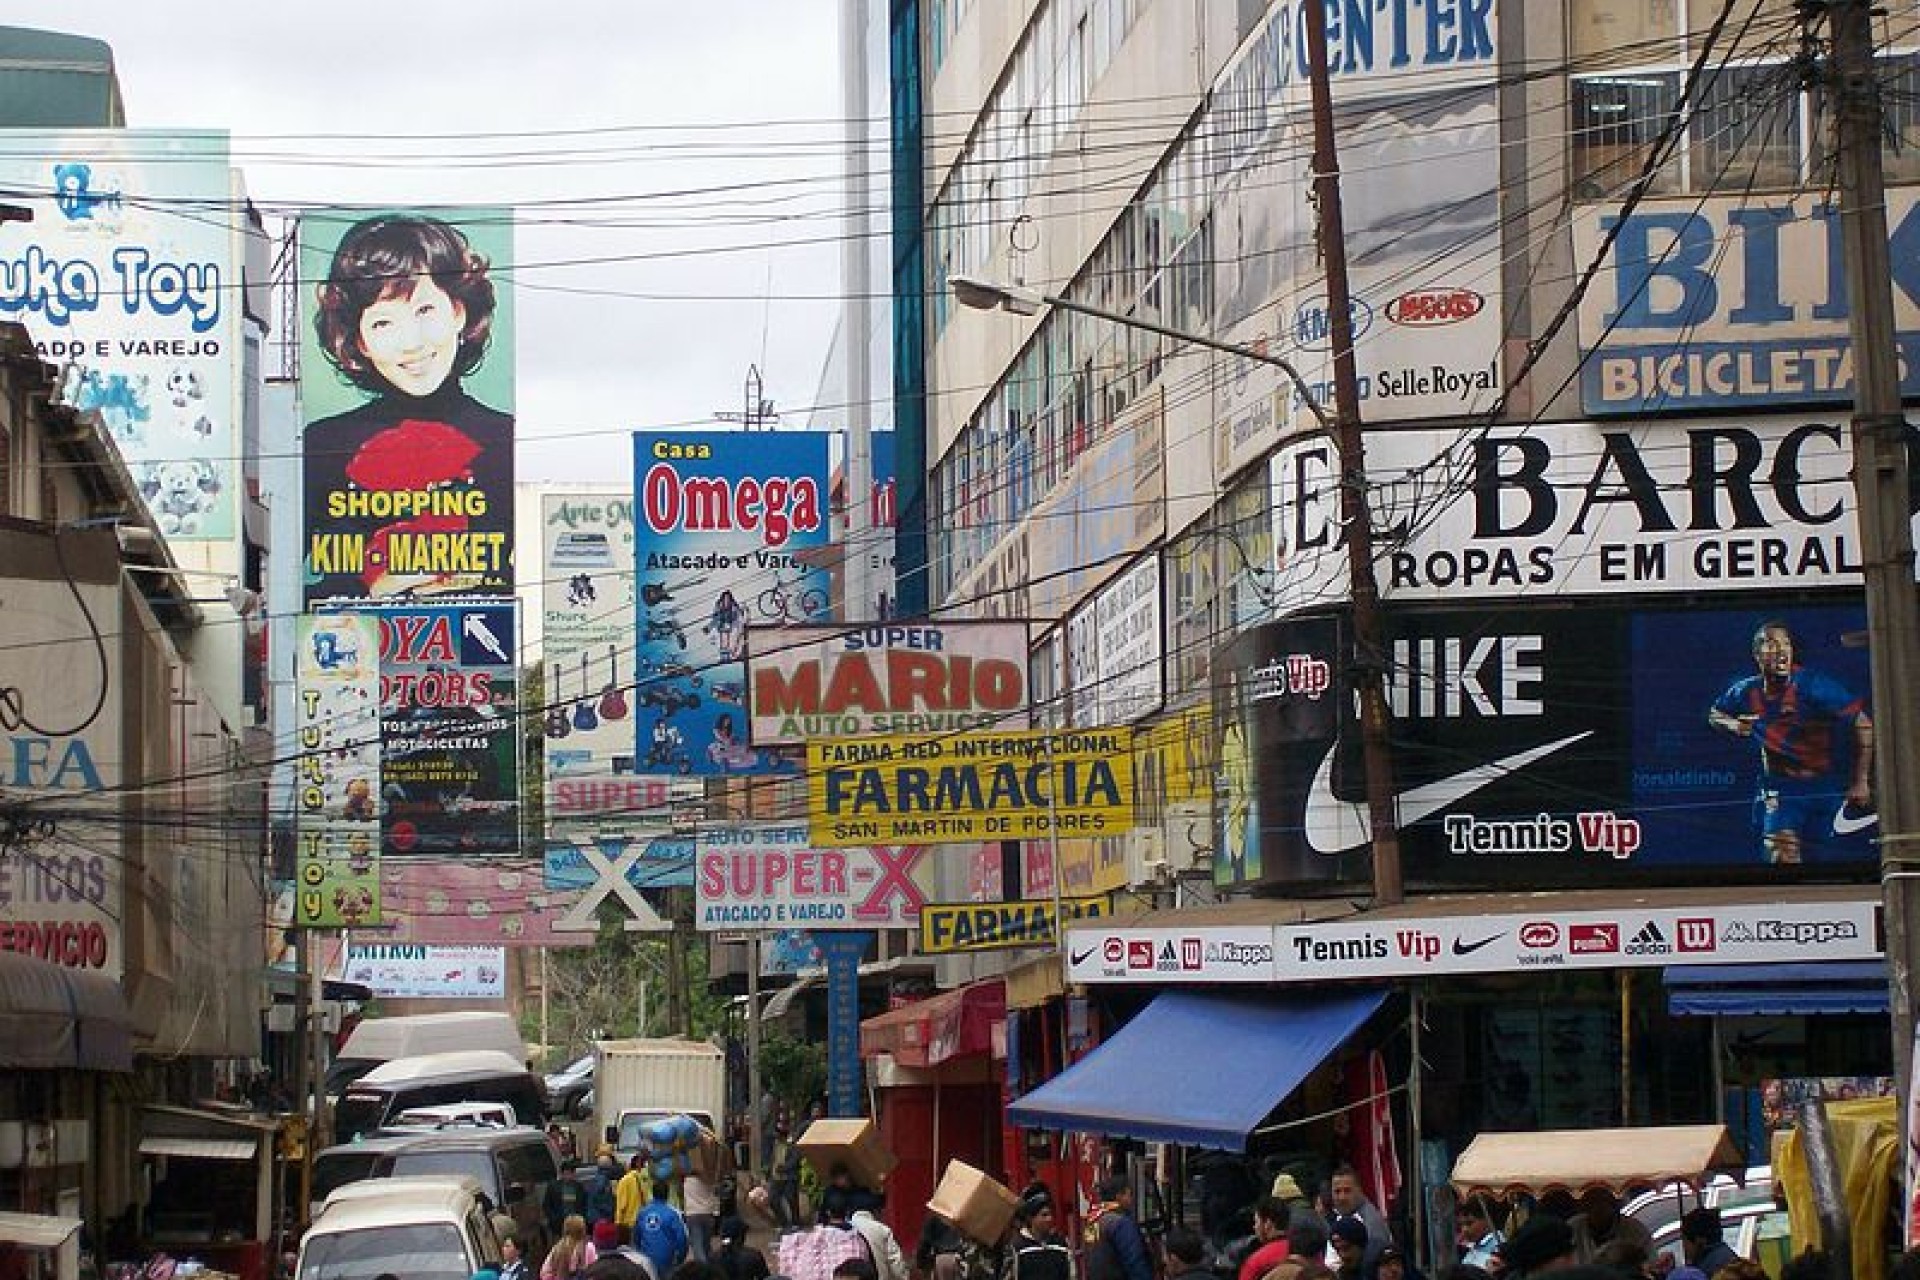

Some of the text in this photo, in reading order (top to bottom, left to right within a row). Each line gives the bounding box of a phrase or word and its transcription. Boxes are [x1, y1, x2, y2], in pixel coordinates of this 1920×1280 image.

[113, 247, 221, 333] Toy
[95, 340, 109, 357] E
[119, 339, 220, 357] VAREJO
[1377, 370, 1430, 399] Selle
[1432, 360, 1498, 401] Royal
[653, 442, 712, 460] Casa
[1472, 416, 1920, 541] BARC
[328, 490, 488, 518] SHOPPING
[642, 462, 821, 547] Omega
[311, 532, 506, 574] KIM MARKET
[646, 550, 731, 570] Atacado
[1390, 535, 1866, 588] ROPAS EM GERAL
[844, 626, 943, 651] SUPER
[755, 650, 1023, 717] MARIO
[1286, 653, 1330, 701] Vip
[779, 714, 860, 737] AUTO
[0, 736, 105, 792] FA
[823, 742, 893, 762] FARMA
[555, 783, 668, 812] SUPER
[824, 759, 1122, 815] FARMACIA
[834, 821, 879, 840] SAN
[892, 817, 973, 839] MARTIN
[984, 814, 1012, 833] DE
[1446, 812, 1641, 859] Tennis Vip
[705, 902, 846, 922] ATACADO E VAREJO
[1293, 930, 1442, 961] Tennis Vip
[1756, 920, 1858, 945] Kappa
